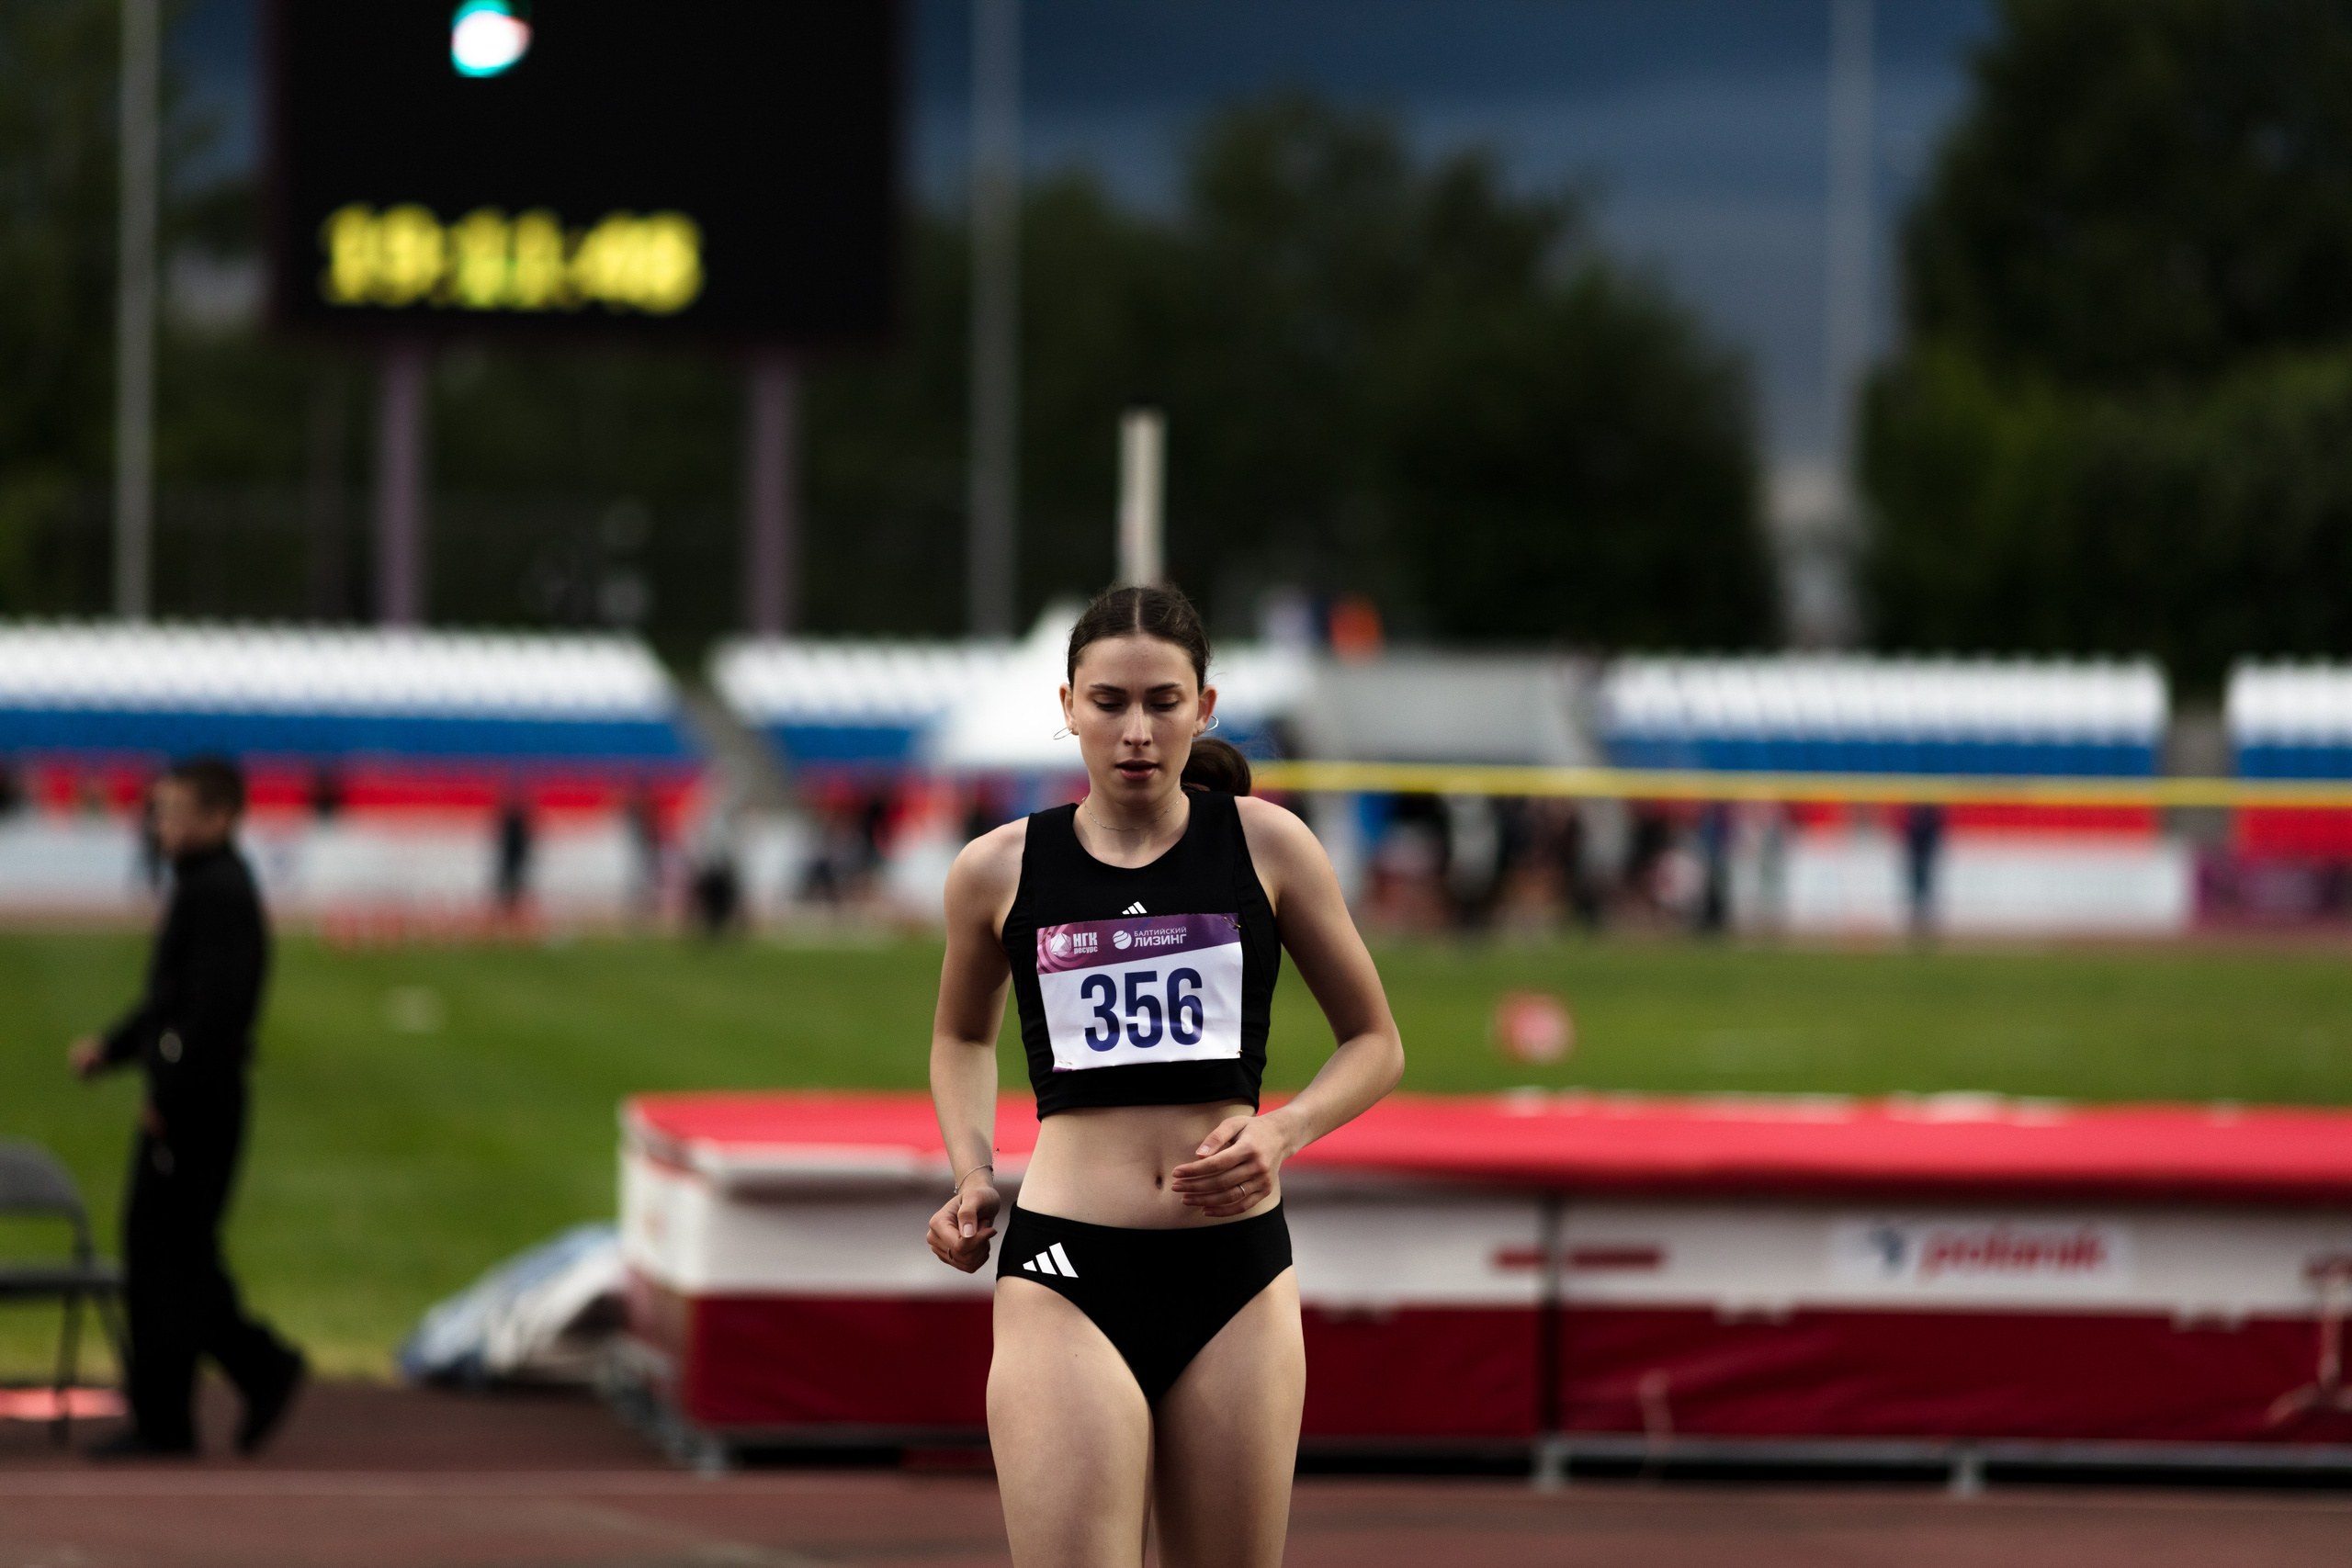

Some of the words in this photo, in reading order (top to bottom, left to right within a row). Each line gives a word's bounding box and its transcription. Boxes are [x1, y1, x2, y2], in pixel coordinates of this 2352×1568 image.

[1134, 926, 1187, 937] БАЛТИЙСКИЙ
[1073, 932, 1098, 947] НГК
[1134, 933, 1187, 947] ЛИЗИНГ
[1073, 946, 1098, 954] ресурс
[1080, 967, 1204, 1052] 356
